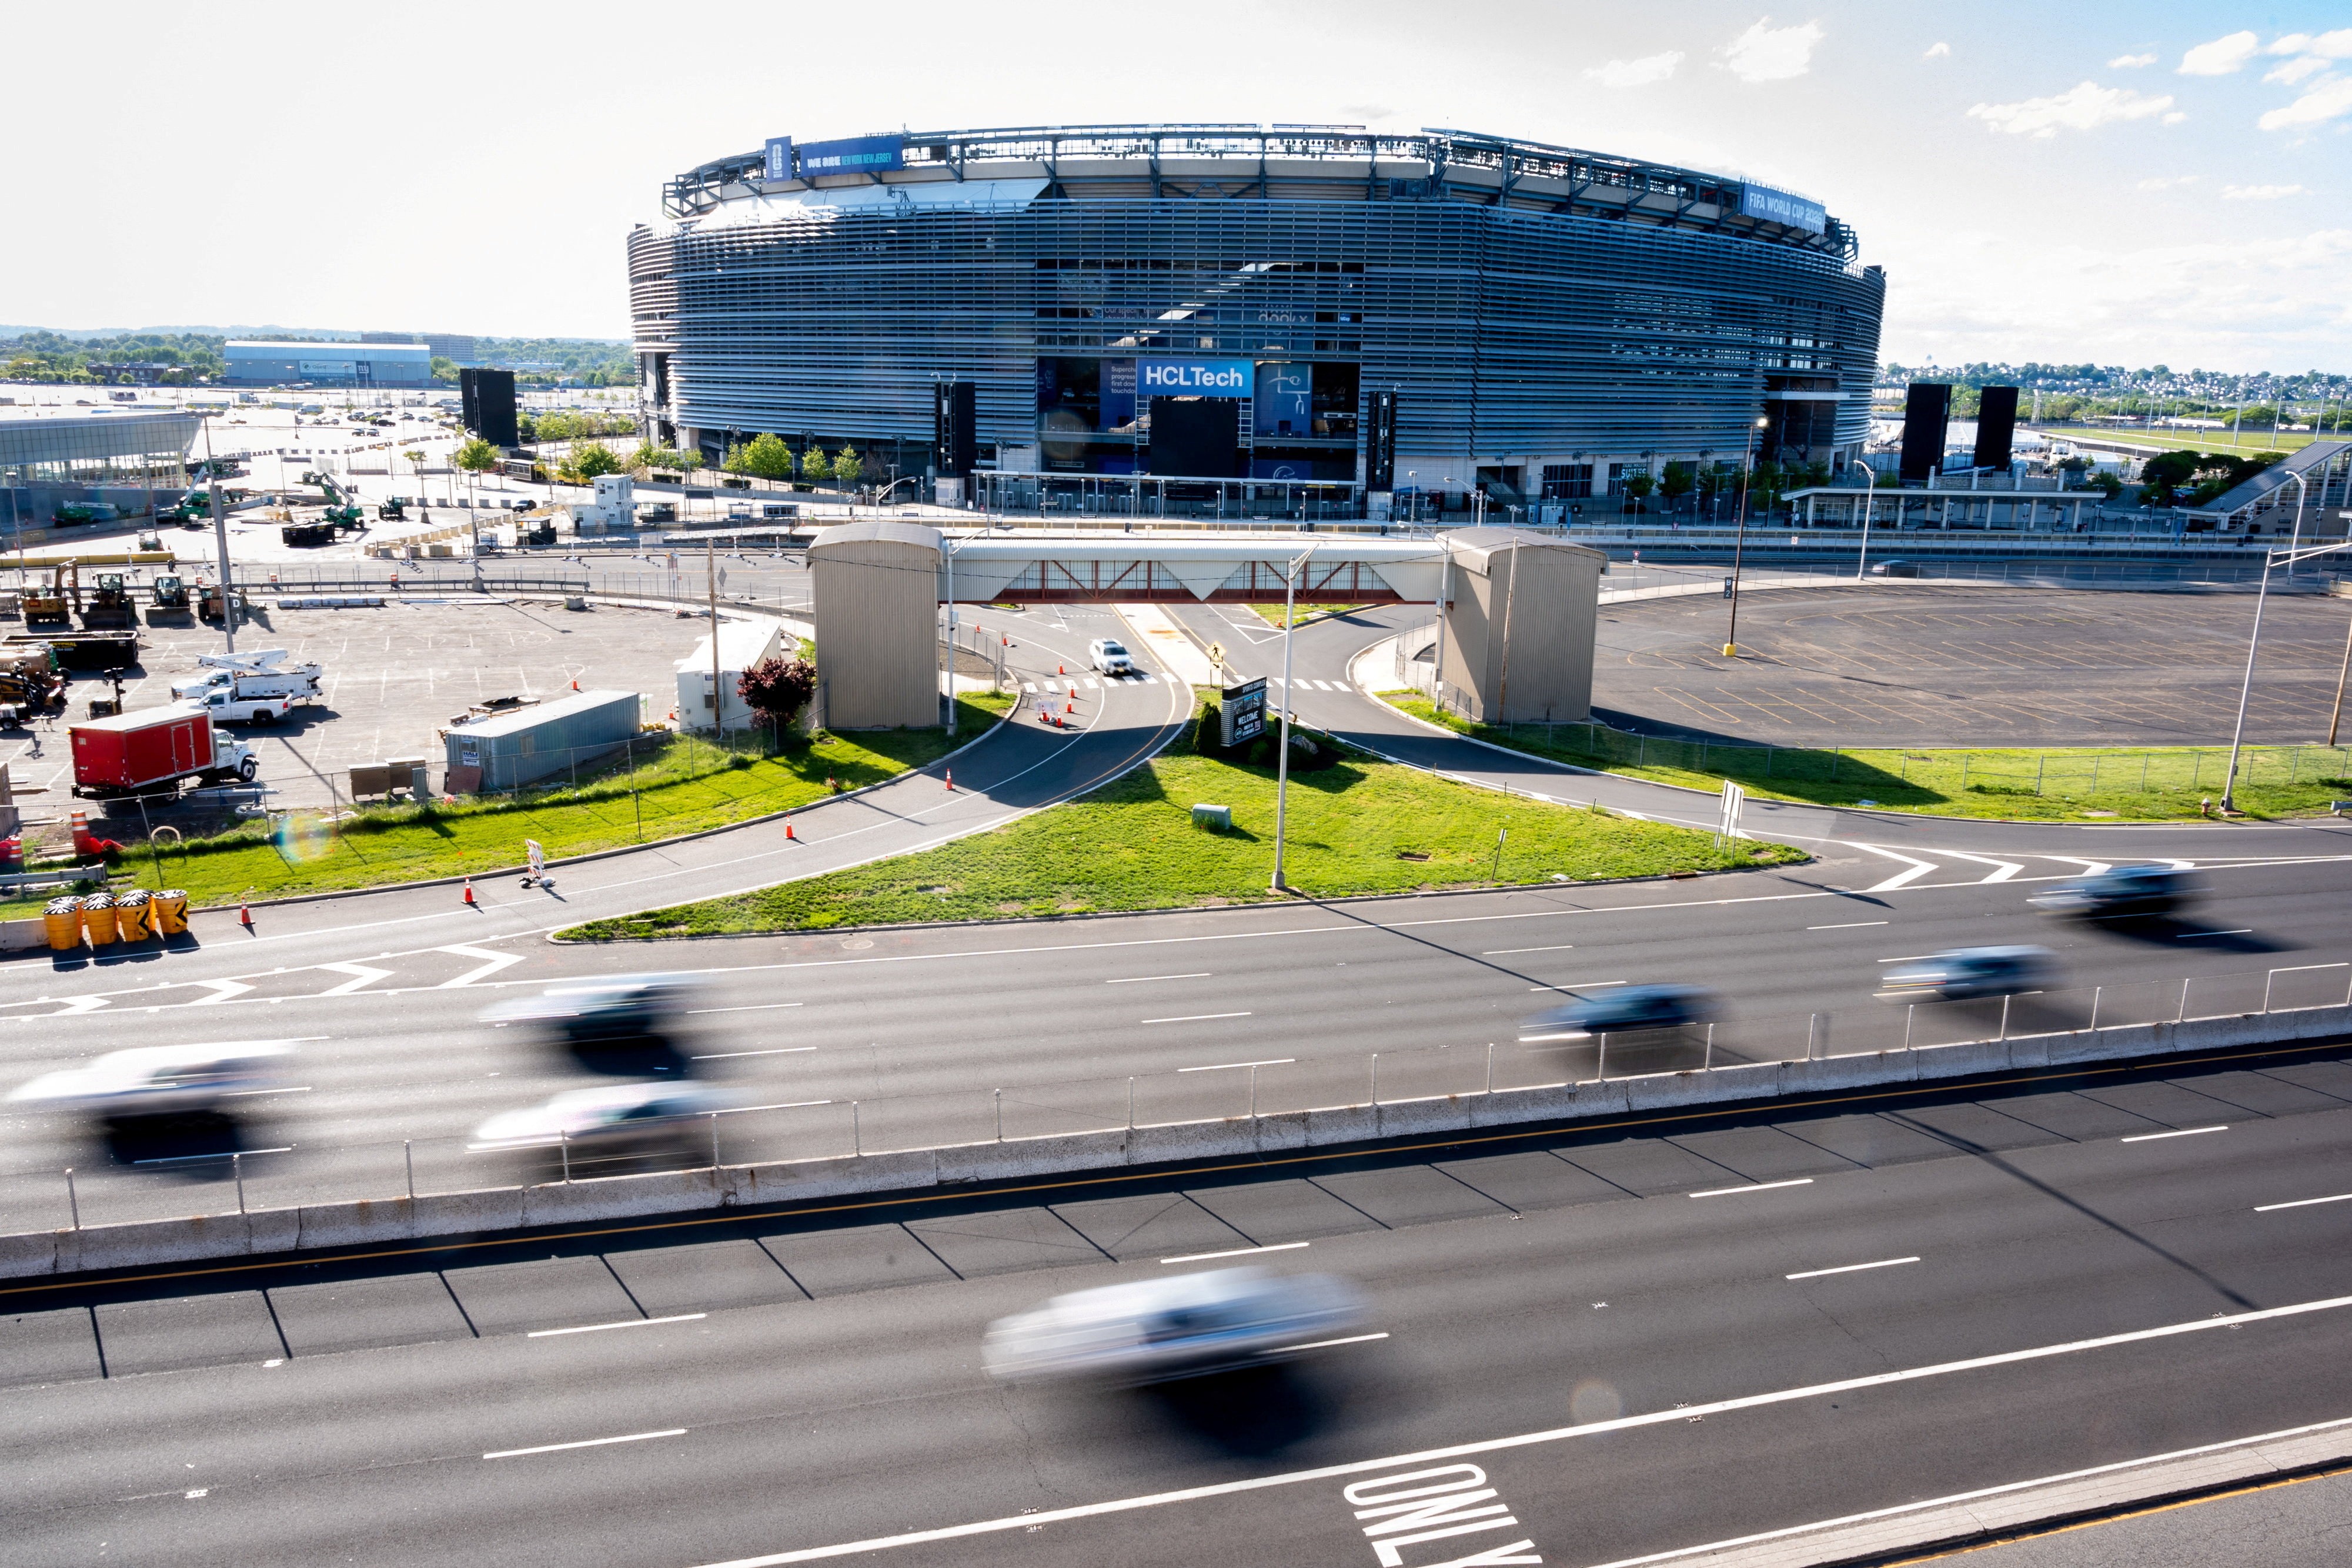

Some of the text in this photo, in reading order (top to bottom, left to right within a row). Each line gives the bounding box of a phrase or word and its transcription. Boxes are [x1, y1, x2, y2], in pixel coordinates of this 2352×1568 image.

[807, 152, 892, 168] WE ARE NEW YORK NEW JERSEY
[1749, 192, 1822, 225] FIFA WORLD CUP 2026
[1146, 366, 1242, 387] HCLTech
[232, 599, 240, 607] D
[235, 613, 240, 621] 1
[1242, 679, 1266, 694] SPORTS COMPLEX
[1238, 710, 1258, 726] WELCOME
[1344, 1463, 1542, 1568] ONLY
